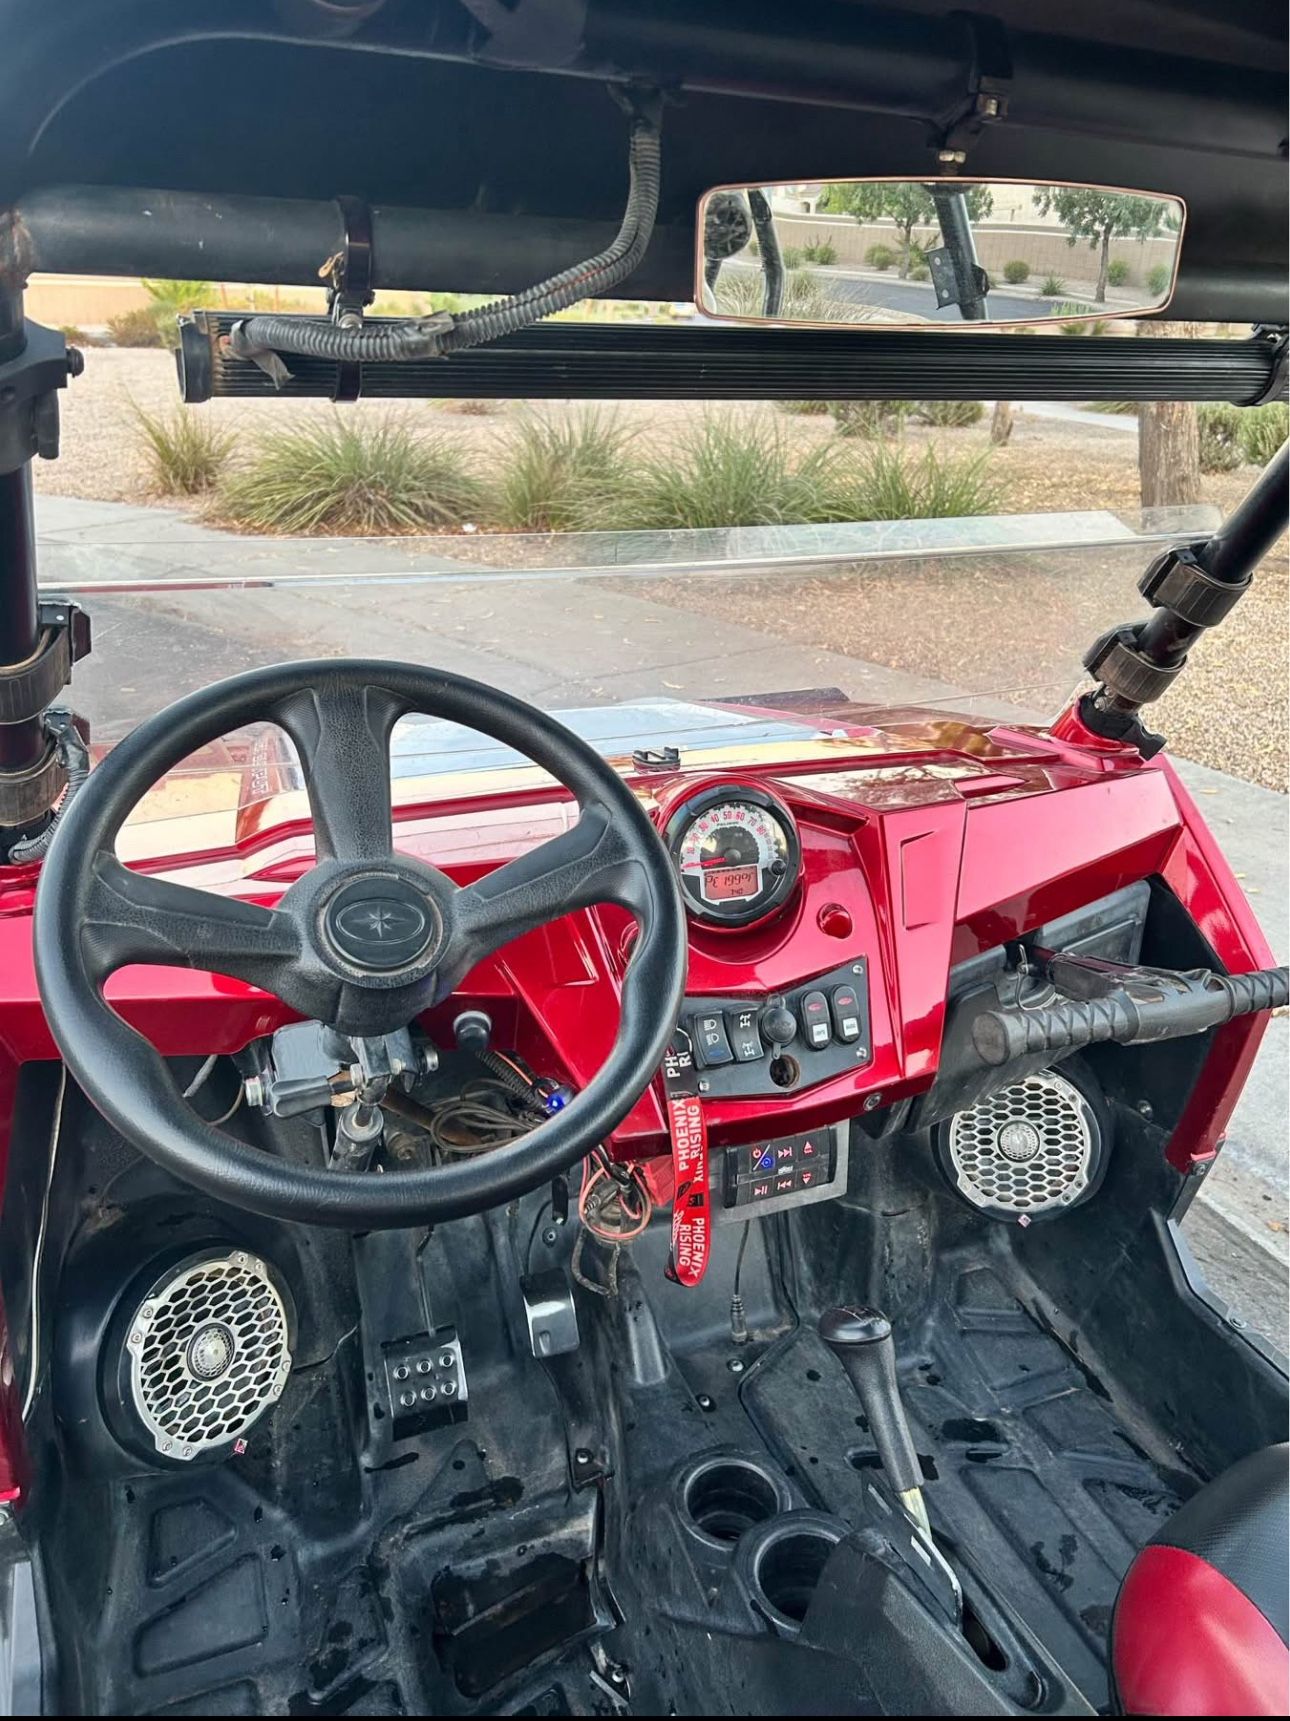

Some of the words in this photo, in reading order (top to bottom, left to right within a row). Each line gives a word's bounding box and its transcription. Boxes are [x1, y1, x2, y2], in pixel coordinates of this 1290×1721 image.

[711, 814, 719, 823] 40
[723, 811, 732, 820] 50
[736, 812, 745, 820] 60
[672, 1099, 690, 1172] PHOENIX
[687, 1104, 702, 1160] RISING
[679, 1223, 692, 1267] RISING
[688, 1216, 705, 1278] PHOENIX
